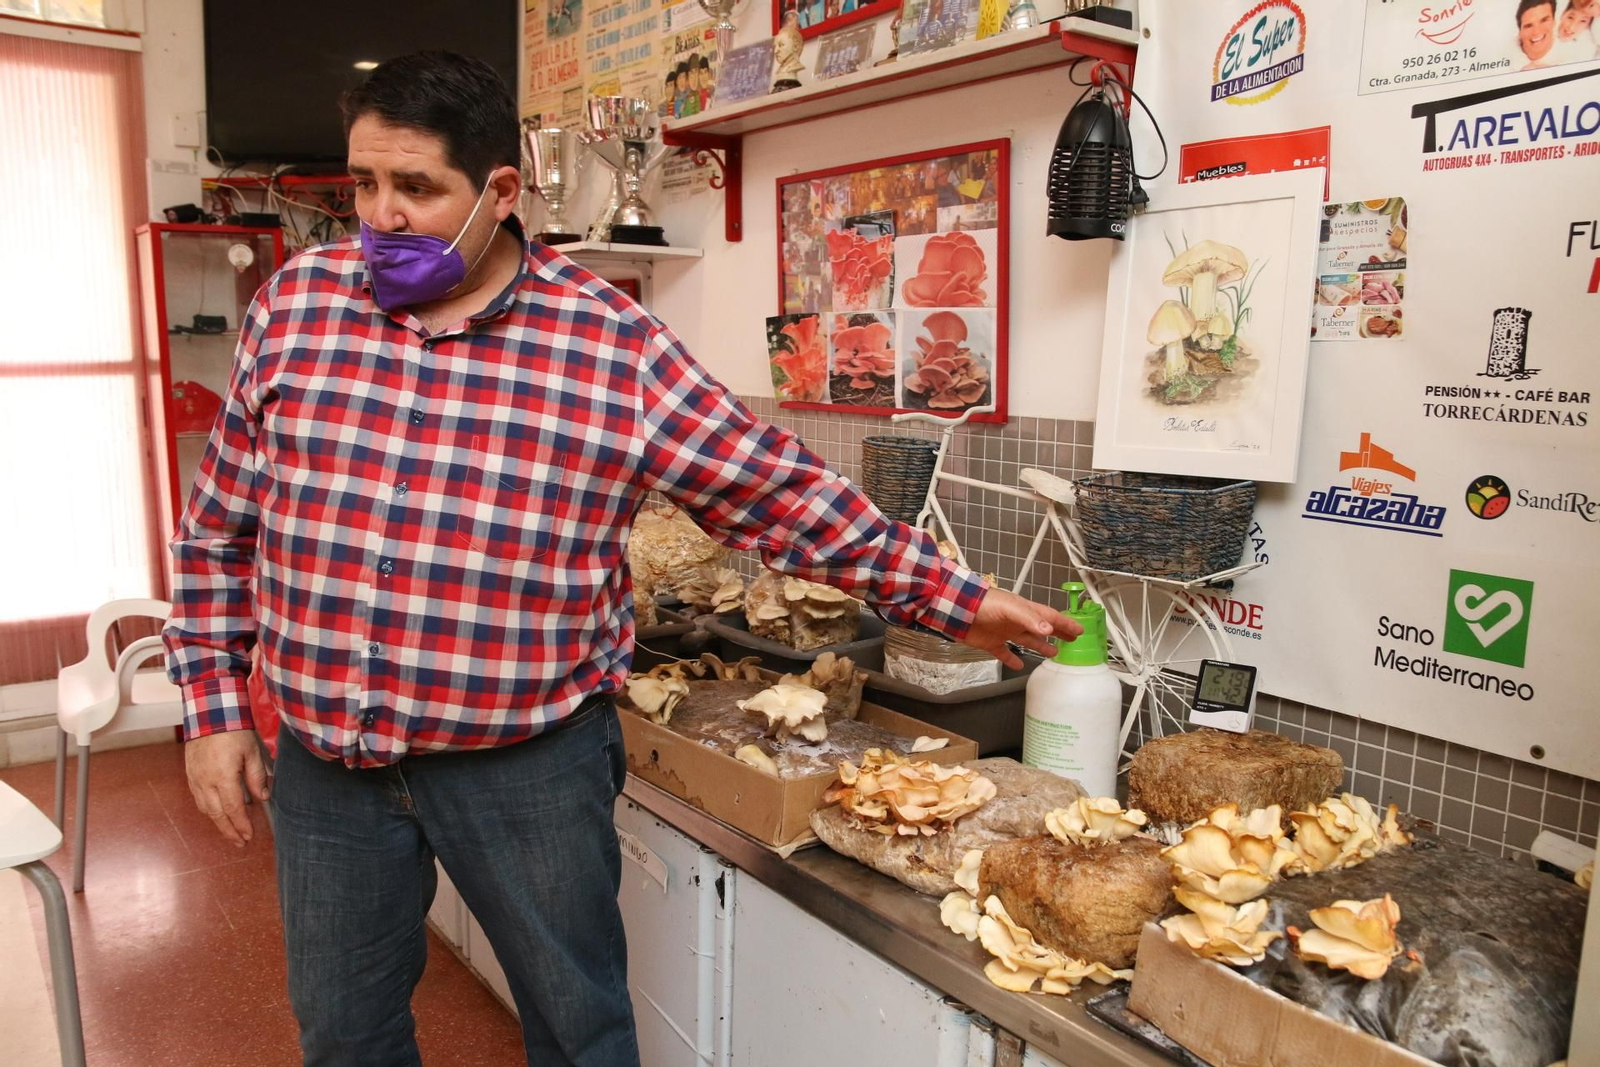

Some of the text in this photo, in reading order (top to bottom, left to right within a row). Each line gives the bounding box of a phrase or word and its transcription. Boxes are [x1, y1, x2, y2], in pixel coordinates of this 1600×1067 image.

[1221, 15, 1295, 80] El Super
[1402, 47, 1477, 69] 950 26 02 16
[1215, 56, 1301, 99] DE LA ALIMENTACION
[1369, 77, 1391, 87] Ctra.
[1393, 70, 1439, 84] Granada,
[1441, 66, 1460, 77] 273
[1468, 57, 1511, 73] Almería
[1422, 154, 1473, 172] AUTOGRUAS
[1475, 153, 1492, 167] 4X4
[1500, 145, 1565, 165] TRANSPORTES
[1197, 163, 1244, 180] Muebles
[1334, 219, 1378, 229] SUMINISTROS
[1327, 260, 1354, 268] Taberner
[1320, 317, 1356, 327] Taberner
[1425, 384, 1481, 399] PENSIÓN
[1514, 388, 1554, 402] CAFÉ
[1558, 391, 1591, 404] BAR
[1423, 403, 1588, 427] TORRECÁRDENAS
[1351, 476, 1393, 496] Viajes
[1305, 485, 1447, 530] alcazaba
[1516, 488, 1600, 523] SandiRe
[1377, 615, 1435, 646] Sano
[1374, 645, 1534, 701] Mediterraneo
